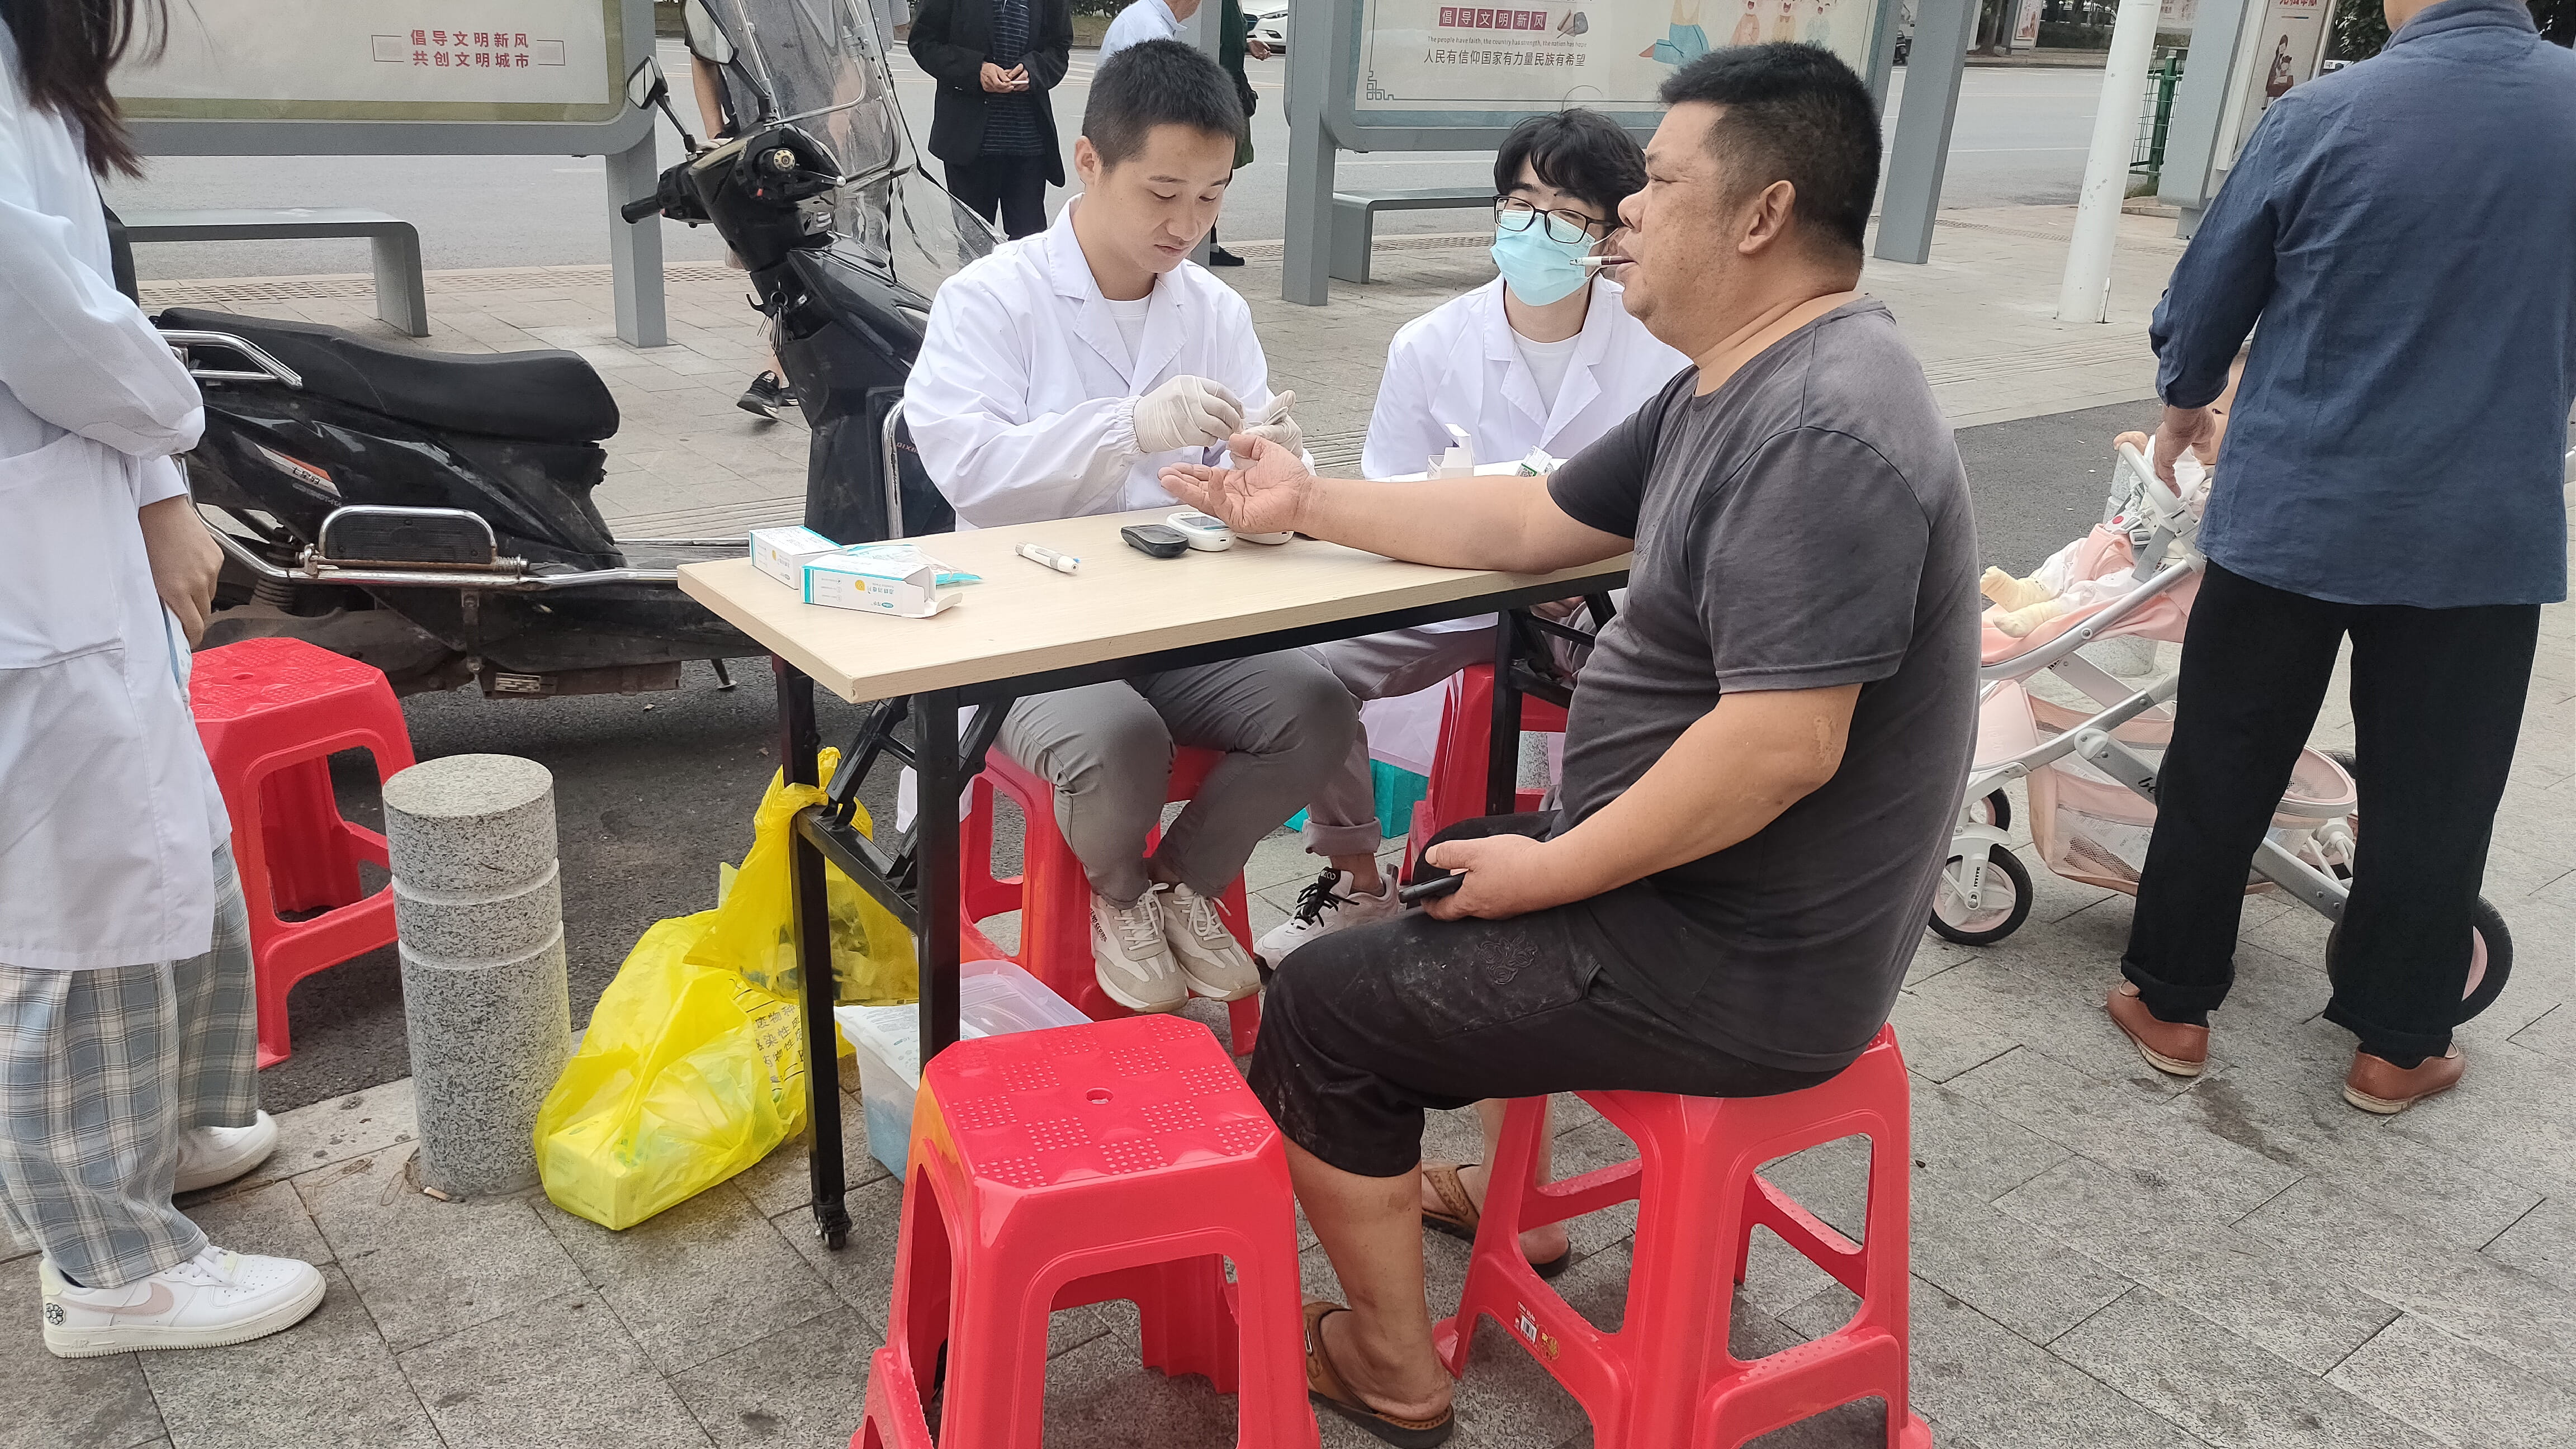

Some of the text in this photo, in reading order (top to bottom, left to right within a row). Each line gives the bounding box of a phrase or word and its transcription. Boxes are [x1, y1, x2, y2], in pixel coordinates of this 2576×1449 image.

[1441, 10, 1545, 29] 倡导文明新风
[410, 30, 529, 48] 倡导文明新风
[413, 50, 529, 68] 共创文明城市
[1424, 48, 1586, 67] 人民有信仰国家有力量民族有希望
[755, 1003, 800, 1029] 废物种
